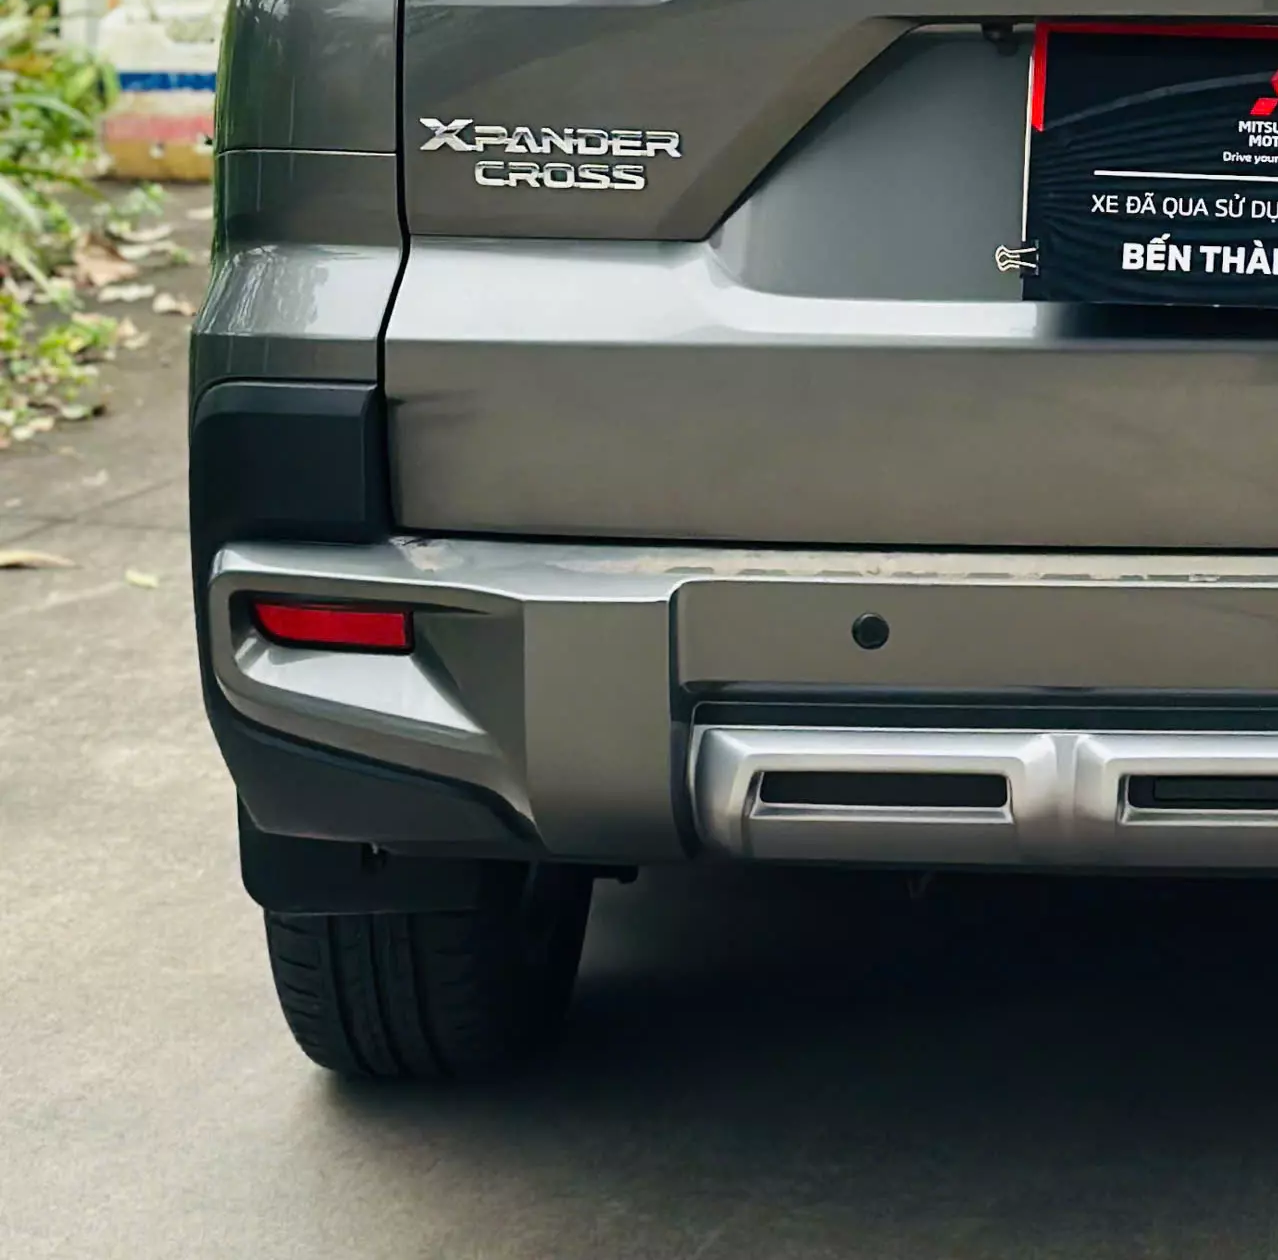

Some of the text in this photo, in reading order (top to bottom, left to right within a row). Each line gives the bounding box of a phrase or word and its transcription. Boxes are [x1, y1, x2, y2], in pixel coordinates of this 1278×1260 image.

[419, 117, 682, 158] XPANDER
[1222, 151, 1252, 163] Drive
[1254, 155, 1278, 165] your
[474, 160, 646, 190] CROSS
[1091, 194, 1119, 214] XE
[1125, 192, 1157, 215] ĐÃ
[1162, 196, 1209, 219] QUA
[1214, 193, 1246, 218] SỬ
[1121, 232, 1192, 272] BẾN
